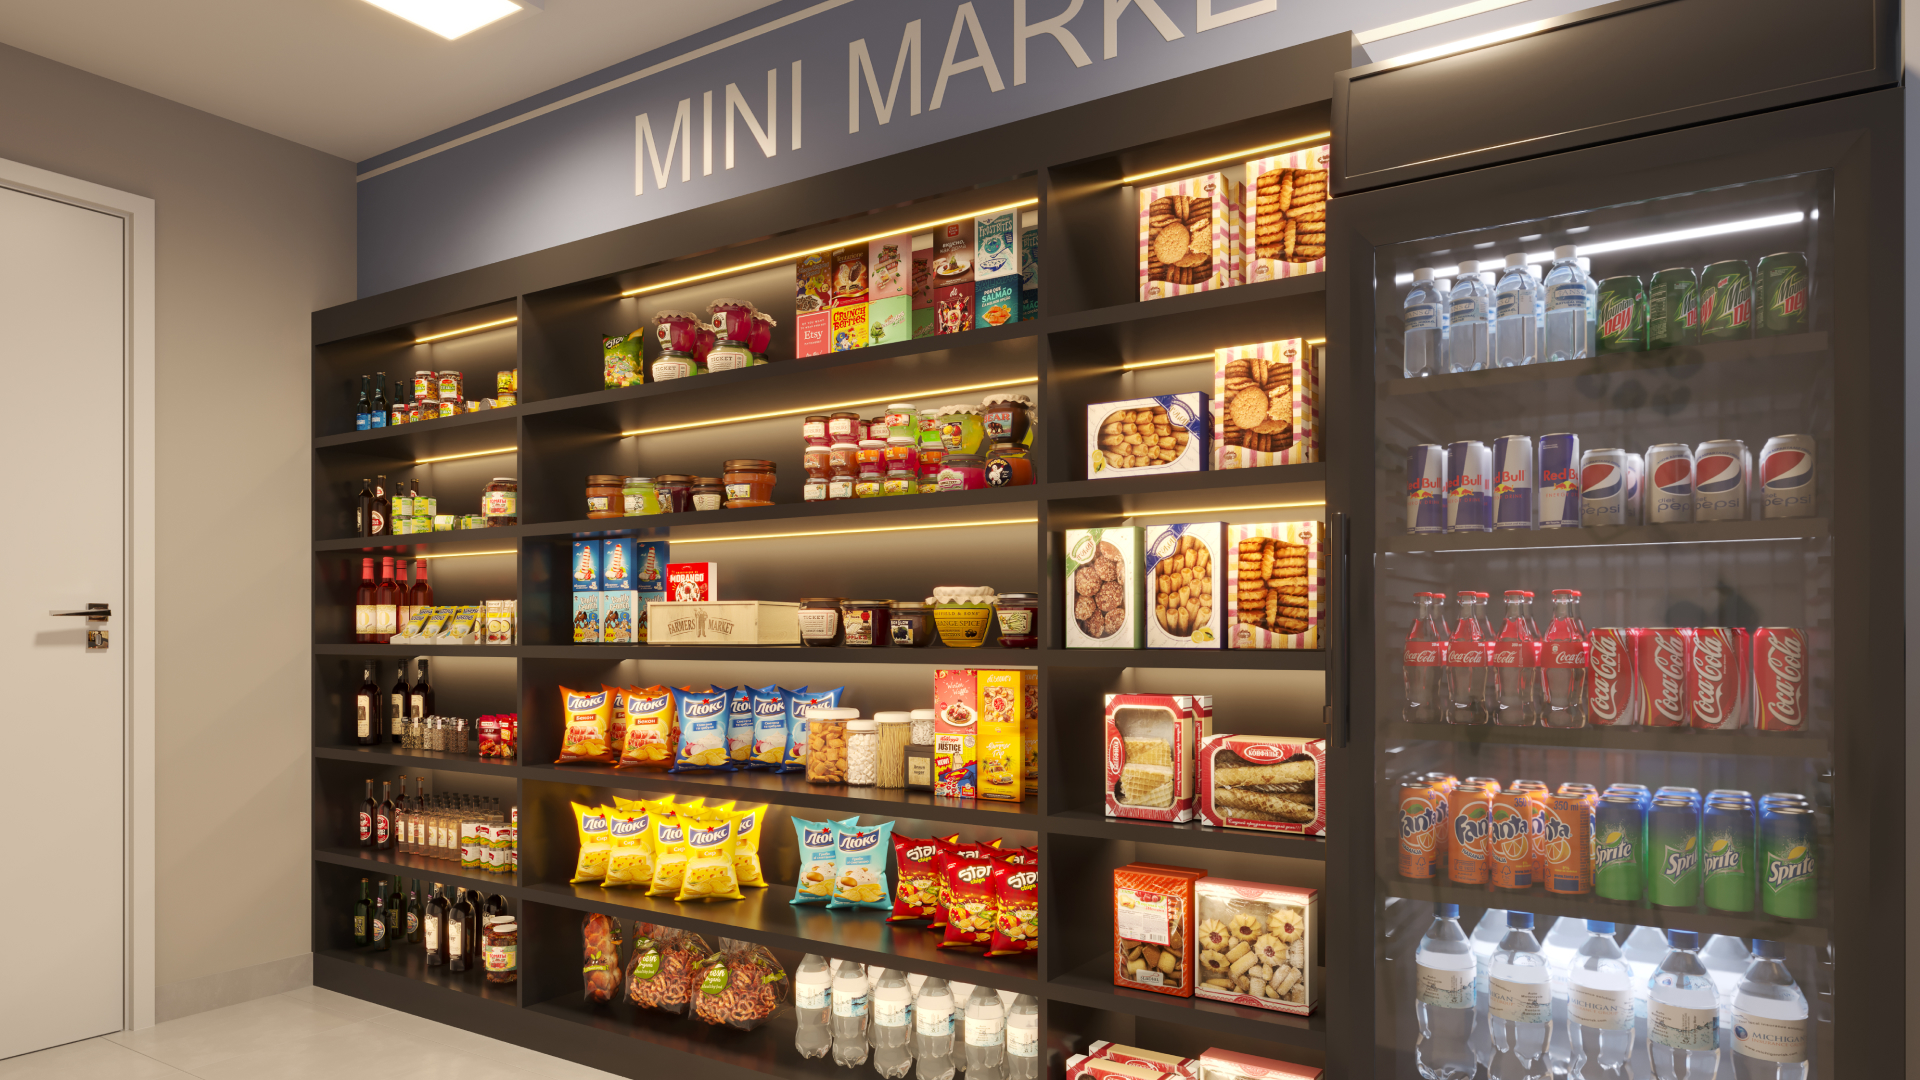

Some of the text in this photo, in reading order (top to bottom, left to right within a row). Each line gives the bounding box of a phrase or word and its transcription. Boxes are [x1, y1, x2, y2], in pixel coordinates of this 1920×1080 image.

[635, 60, 802, 196] MINI
[981, 287, 1013, 303] SALMÃO
[833, 306, 866, 322] CRUNCH
[1600, 297, 1633, 325] Mountain
[803, 329, 824, 341] Etsy
[984, 413, 1010, 424] BEAR
[1461, 474, 1482, 486] Bull
[1502, 470, 1525, 482] Bull
[1543, 468, 1567, 481] Red
[1421, 477, 1441, 489] Bull
[1657, 502, 1690, 513] pep
[670, 573, 704, 583] MORANGO
[667, 619, 735, 635] FARMERS MARKET
[1590, 634, 1618, 720] Coca-Cola
[1655, 631, 1684, 722] Coca-Cola
[1693, 631, 1724, 724] Coca-Cola
[1768, 630, 1802, 726] Coca-Cola
[569, 696, 604, 709] Люкс
[631, 700, 665, 712] Люкс
[685, 701, 723, 716] Люкс
[938, 743, 961, 752] JUSTICE
[1553, 801, 1579, 811] 350 ml
[613, 819, 646, 833] Люкс
[691, 828, 727, 844] Люкс
[839, 834, 877, 849] Люкс
[1462, 848, 1485, 860] NARANJA
[1596, 840, 1632, 865] Sprite
[1665, 850, 1697, 879] Spri
[1767, 855, 1815, 886] Sprite
[970, 877, 986, 885] chips
[1020, 882, 1036, 891] chips
[1571, 998, 1618, 1011] MICHIGAN
[1751, 1038, 1788, 1047] INSURANCE
[1752, 1032, 1805, 1043] MICHIGAN
